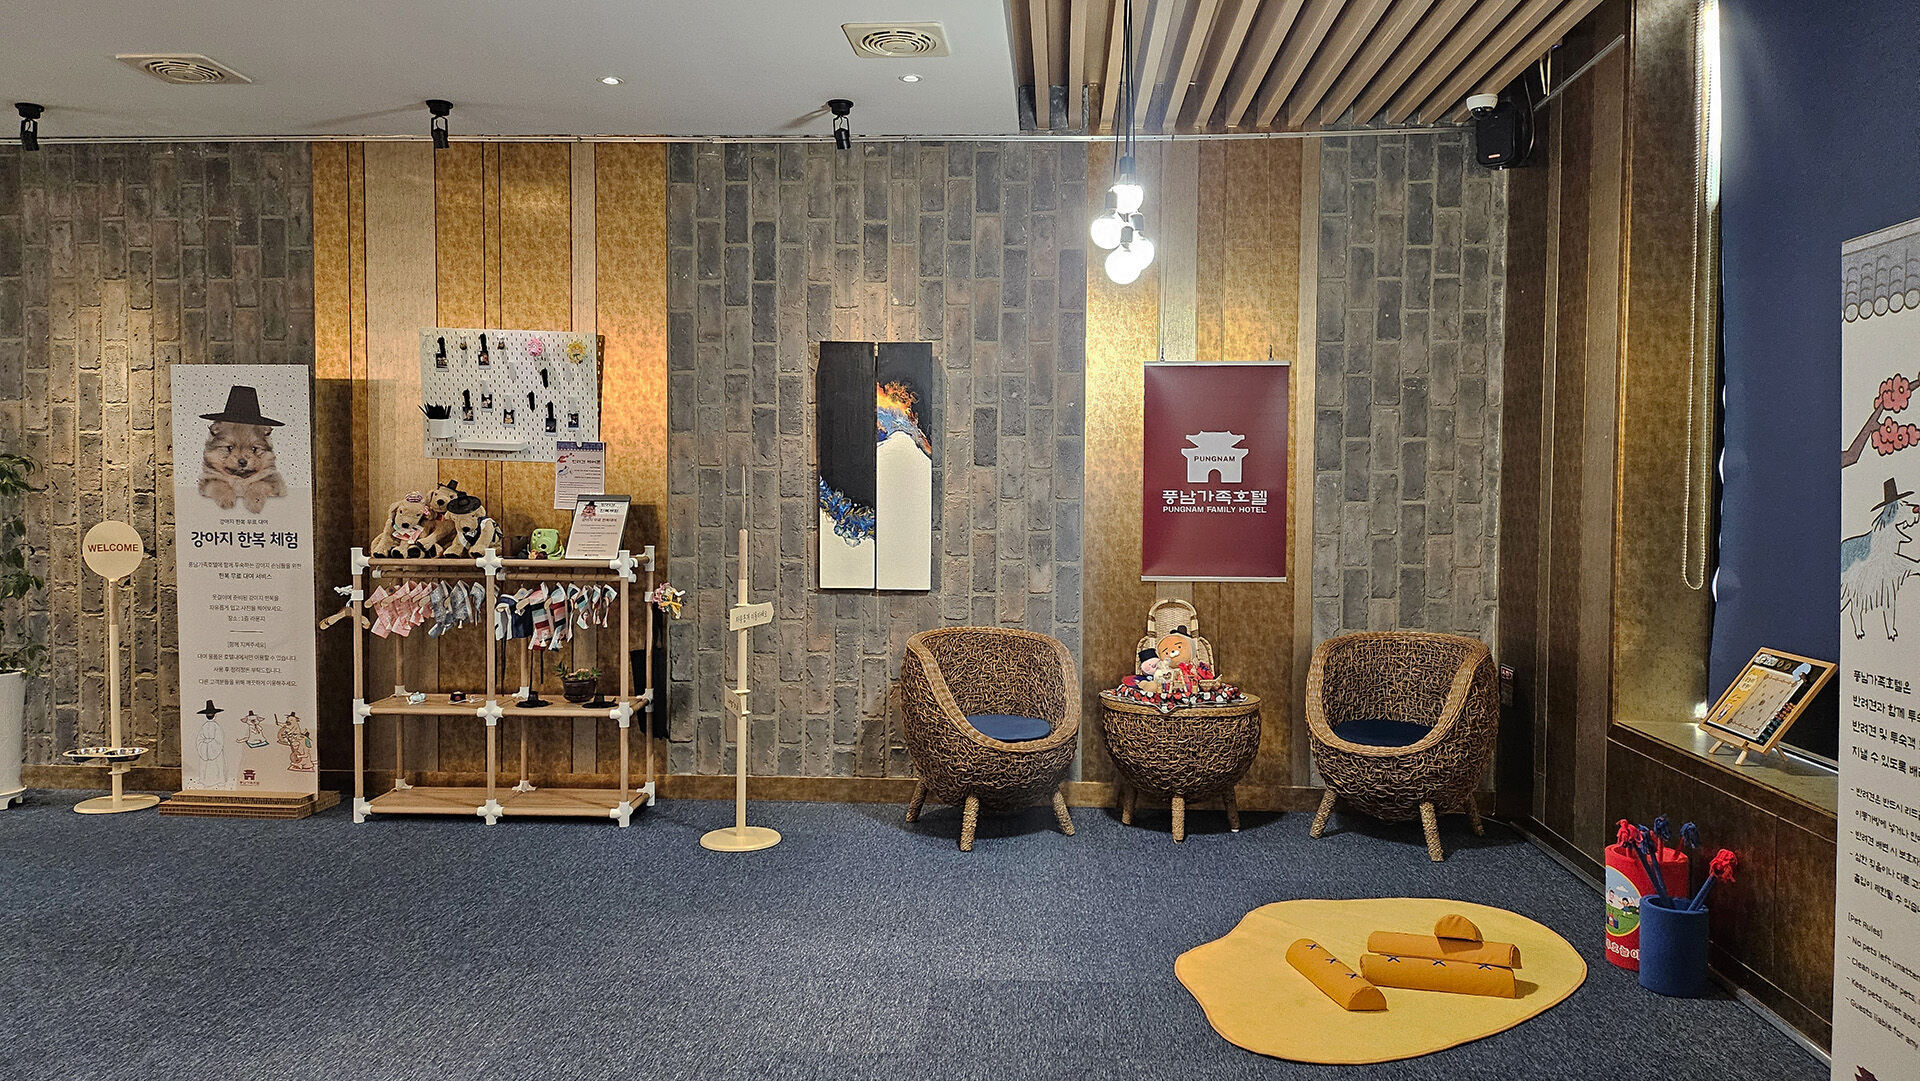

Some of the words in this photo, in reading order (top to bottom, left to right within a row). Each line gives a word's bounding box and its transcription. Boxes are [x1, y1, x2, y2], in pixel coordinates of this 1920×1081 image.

[1162, 490, 1268, 506] 풍남가족호텔
[87, 543, 139, 552] WELCOME
[191, 531, 233, 548] 강아지
[237, 531, 266, 548] 한복
[270, 531, 298, 549] 체험
[1853, 670, 1911, 695] 풍남가족호텔은
[1852, 695, 1885, 714] 반려견과
[1887, 703, 1905, 719] 함께
[1852, 720, 1877, 738] 반려견
[1879, 728, 1888, 740] 및
[1890, 731, 1916, 750] 투숙객
[1852, 746, 1868, 761] 지낼
[1870, 752, 1879, 764] 수
[1881, 754, 1907, 774] 있도록
[1909, 765, 1920, 778] 배
[1856, 788, 1881, 805] 반려견은
[1883, 797, 1903, 813] 반드시
[1904, 806, 1920, 821] 리드
[1855, 810, 1886, 829] 이동가방에
[1888, 821, 1909, 839] 넣거나
[1855, 830, 1874, 847] 반려견
[1876, 840, 1889, 853] 배변
[1890, 847, 1898, 856] 시
[1855, 852, 1867, 866] 심한
[1869, 858, 1895, 878] 짖음이나
[1896, 871, 1910, 886] 다른
[1854, 873, 1873, 890] 출입이
[1874, 884, 1894, 901] 제한될
[1895, 894, 1902, 904] 수
[1903, 897, 1920, 913] 있습
[1848, 912, 1862, 927] [Pet
[1862, 921, 1883, 939] Rules]
[1852, 936, 1862, 947] No
[1862, 943, 1877, 957] pets
[1878, 951, 1892, 965] left
[1851, 957, 1870, 974] Clean
[1870, 969, 1880, 980] up
[1880, 975, 1898, 991] after
[1851, 978, 1867, 993] Keep
[1867, 989, 1883, 1003] pets
[1883, 999, 1902, 1016] quiet
[1902, 1011, 1916, 1025] and
[1850, 998, 1873, 1019] Guests
[1873, 1013, 1892, 1032] liable
[1893, 1026, 1904, 1039] for
[1905, 1036, 1919, 1050] any
